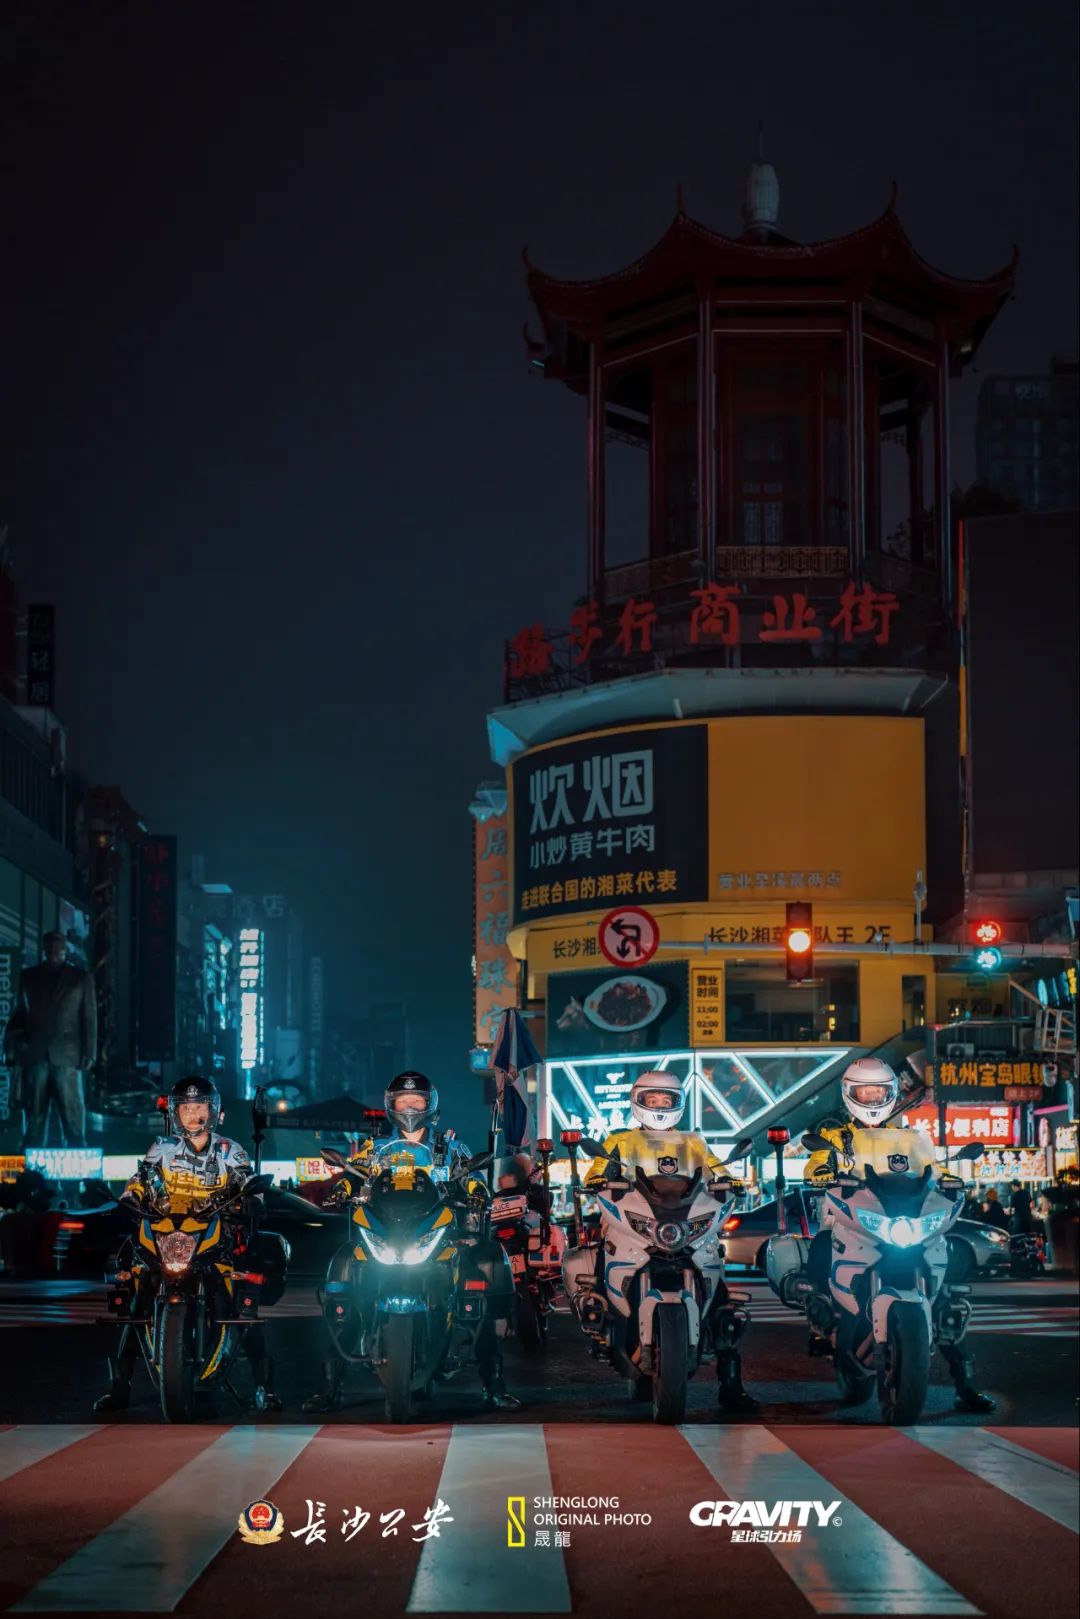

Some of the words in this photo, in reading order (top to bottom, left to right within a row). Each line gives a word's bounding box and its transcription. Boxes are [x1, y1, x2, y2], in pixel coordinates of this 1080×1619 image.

[529, 749, 654, 835] 炊烟
[529, 823, 656, 869] 小炒黄牛肉
[553, 936, 601, 959] 长沙湘
[709, 925, 854, 944] 长沙湘菜队王
